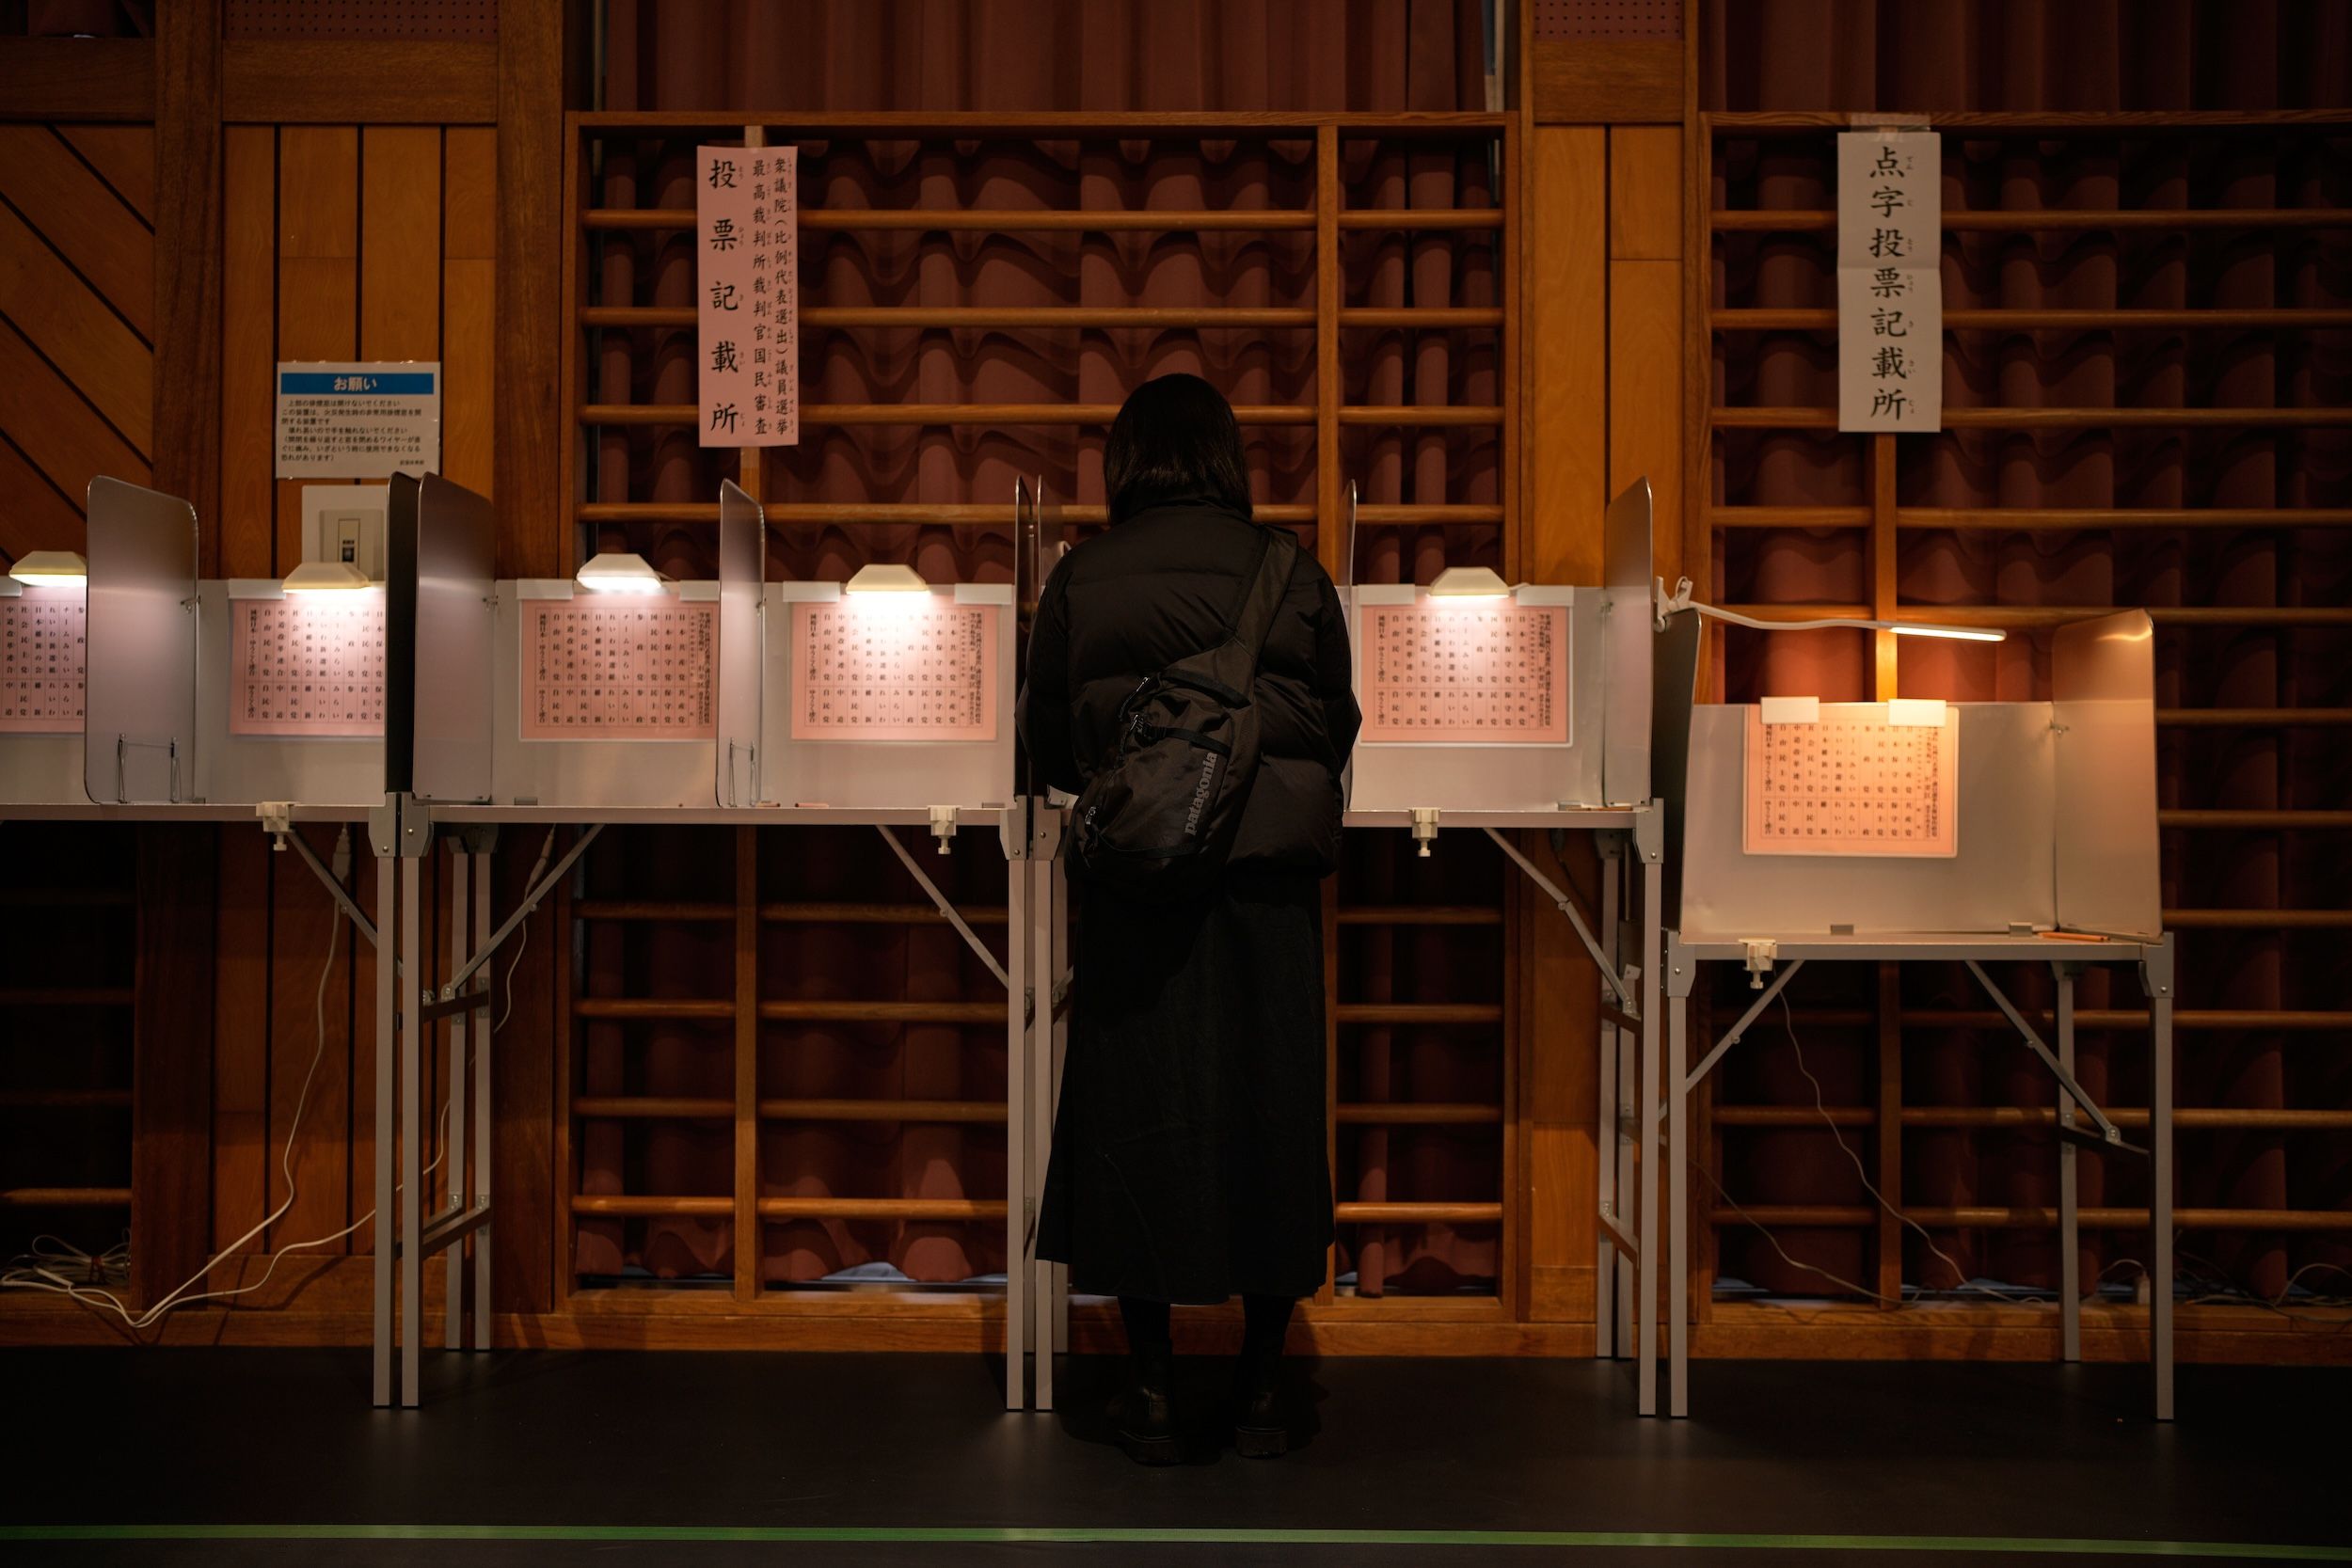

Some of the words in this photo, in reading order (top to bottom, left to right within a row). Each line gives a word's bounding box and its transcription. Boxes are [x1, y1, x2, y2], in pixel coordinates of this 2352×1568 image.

[334, 376, 377, 391] お願い
[709, 159, 739, 435] 投票記載所
[753, 159, 768, 436] 最高裁判所裁判官国民審査
[1868, 146, 1907, 420] 点字投票記載所
[1184, 752, 1218, 836] patagonia
